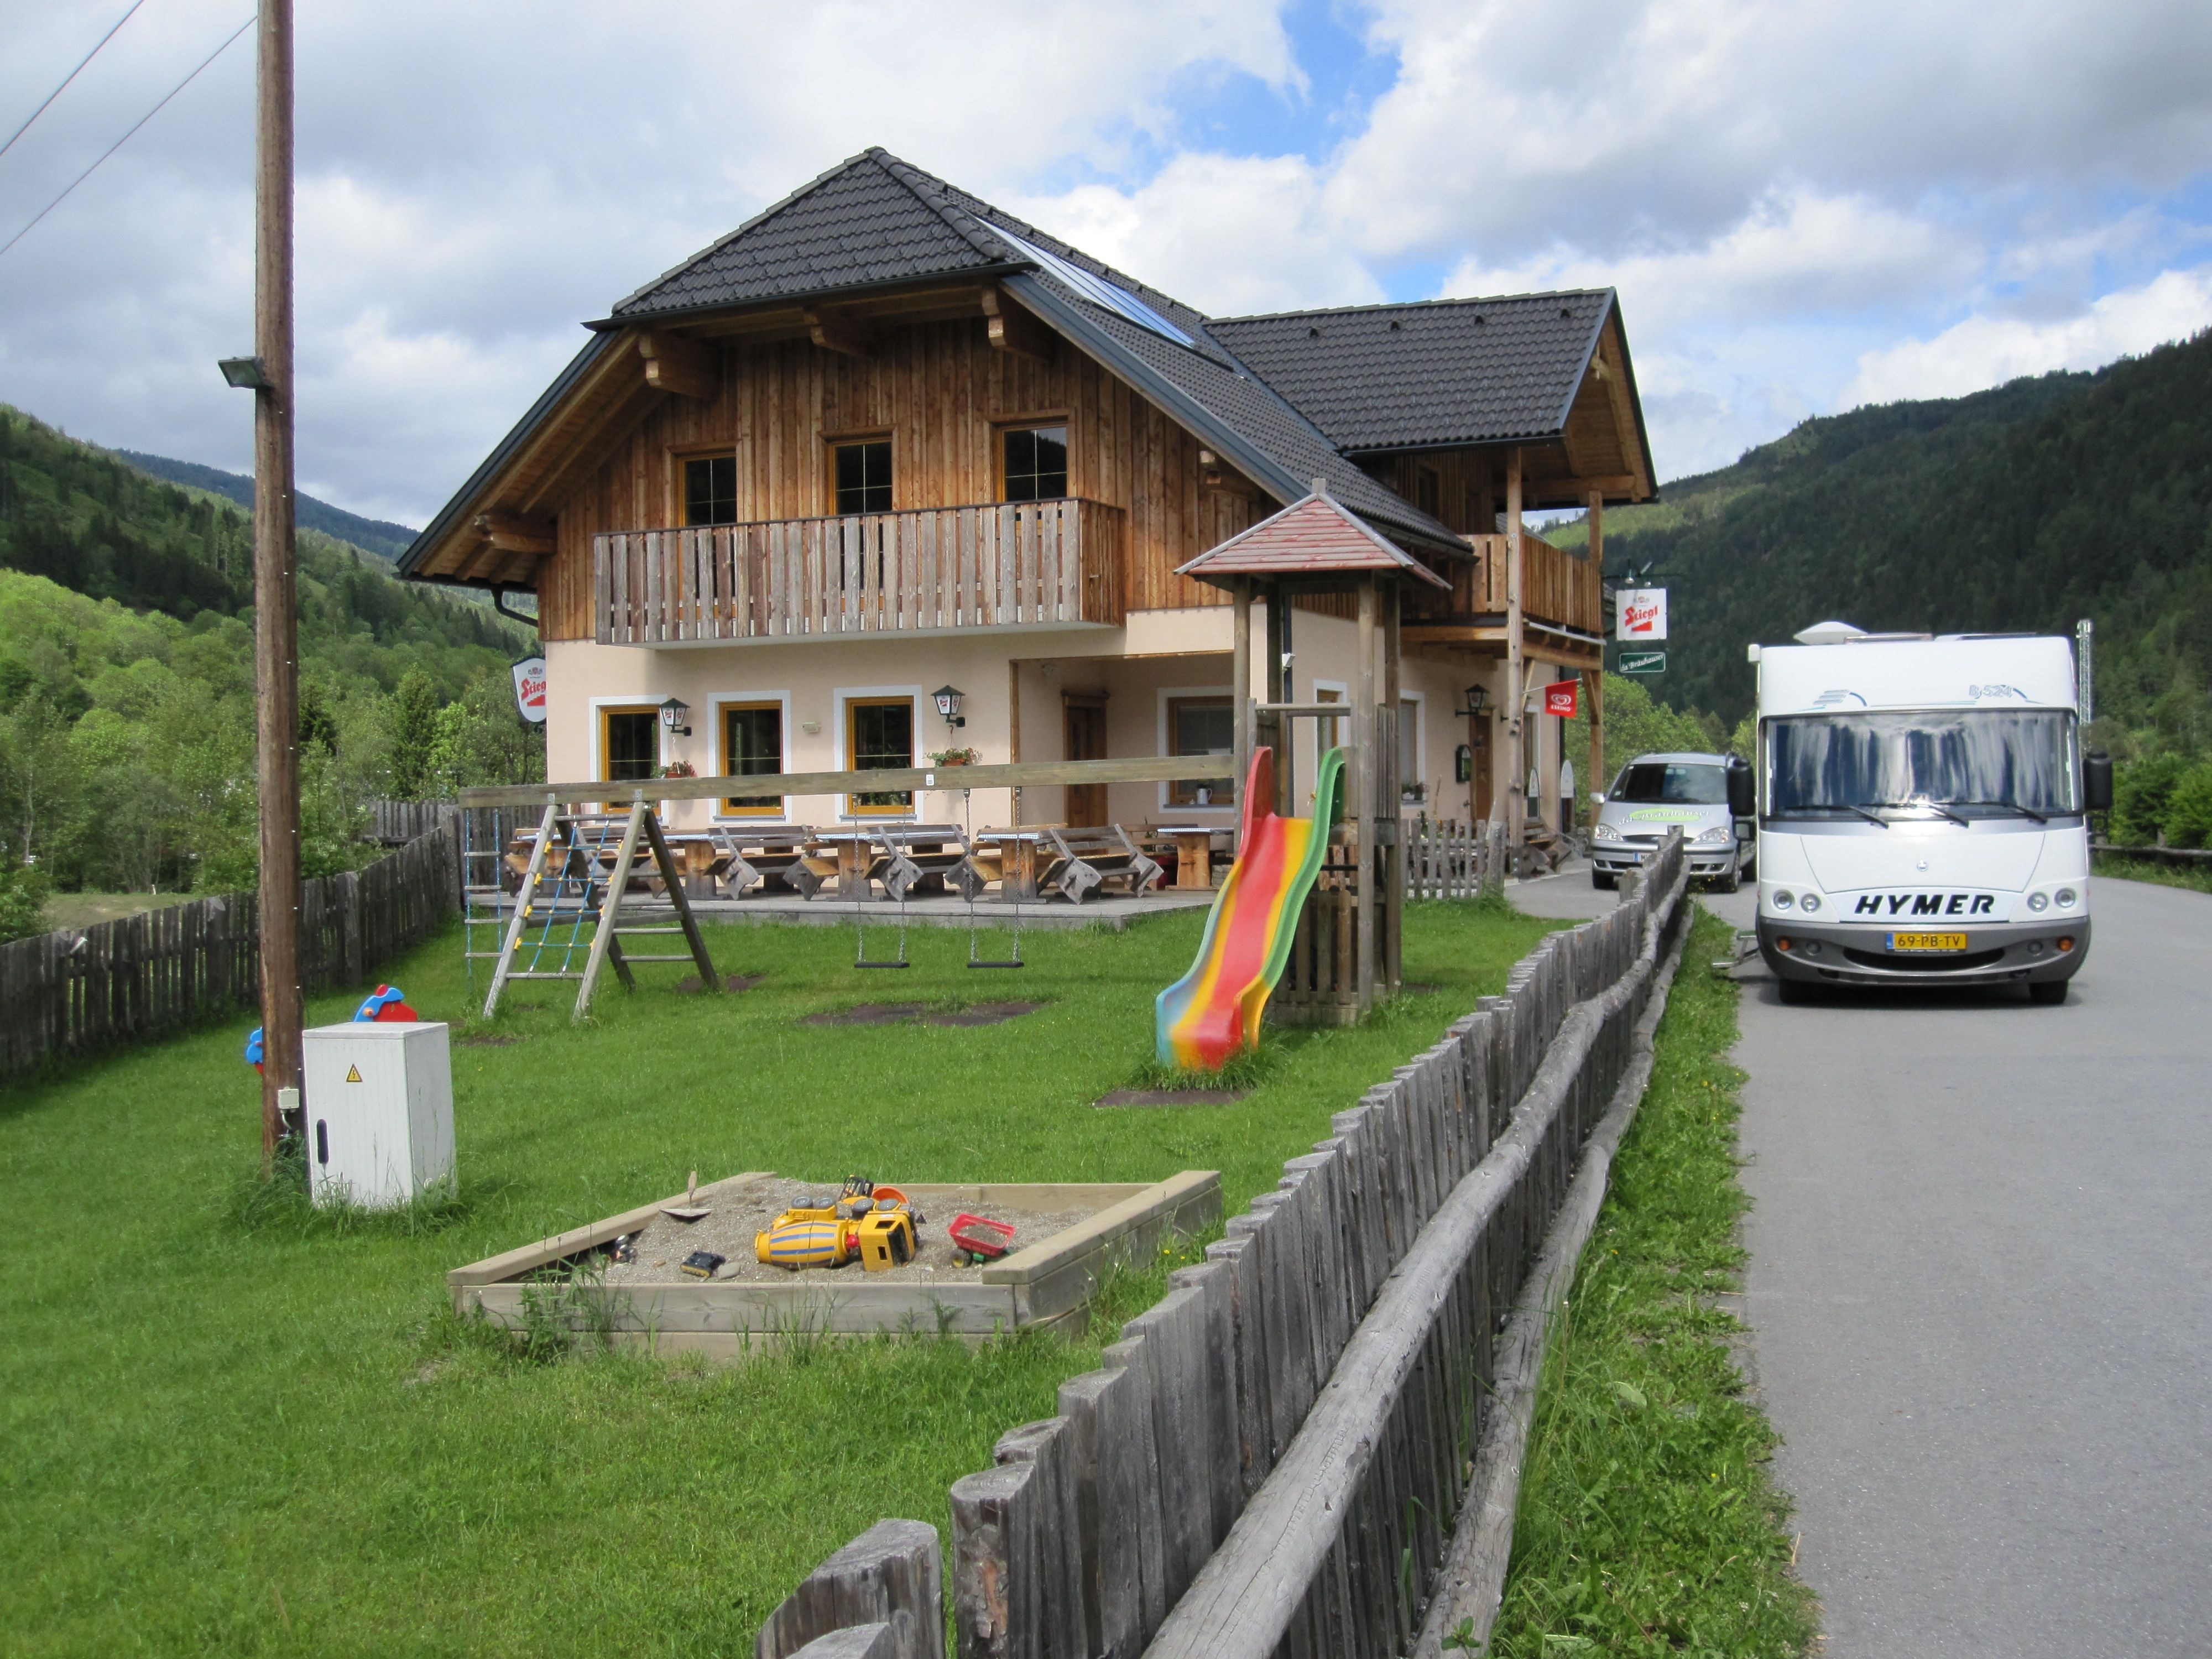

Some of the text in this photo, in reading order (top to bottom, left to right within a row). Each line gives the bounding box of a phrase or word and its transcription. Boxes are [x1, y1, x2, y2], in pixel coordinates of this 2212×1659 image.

[1625, 606, 1658, 627] Stiegl
[521, 678, 546, 701] Stieg
[1854, 895, 1995, 915] HYMER
[1897, 936, 1960, 947] 69-PB-TV
